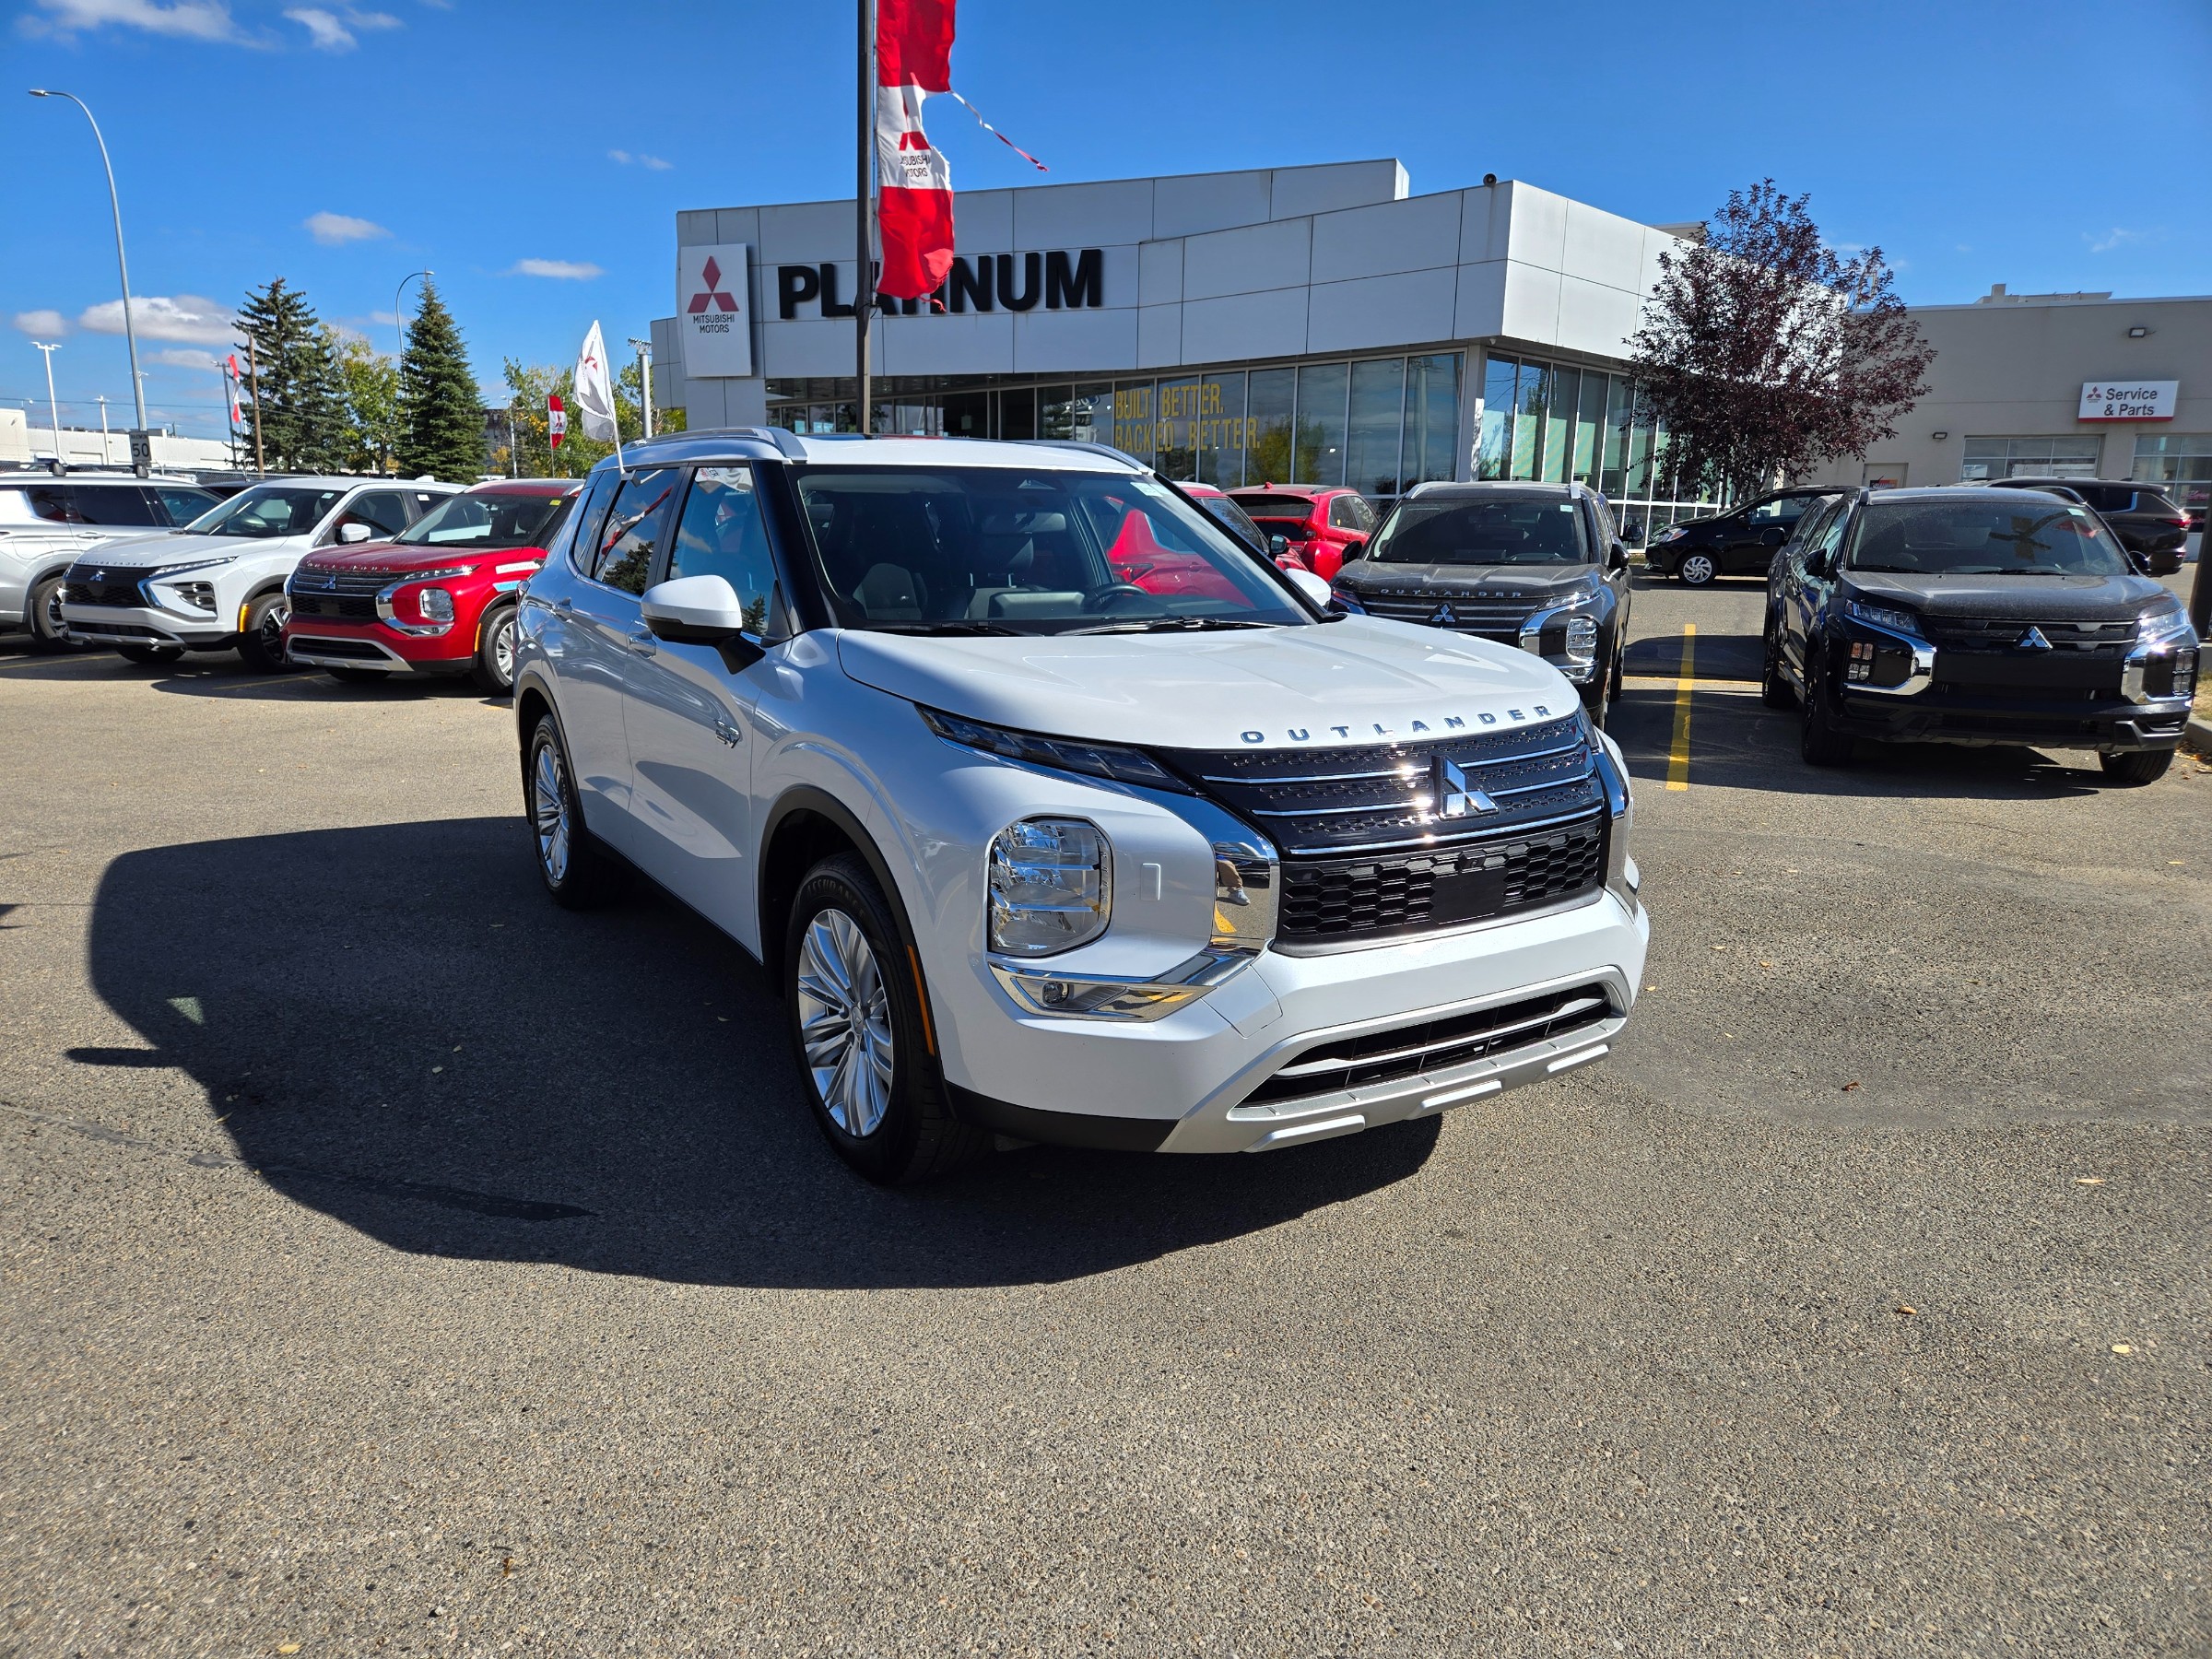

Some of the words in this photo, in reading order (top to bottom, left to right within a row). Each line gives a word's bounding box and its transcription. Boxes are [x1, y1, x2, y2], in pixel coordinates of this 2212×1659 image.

[778, 249, 1102, 319] PLNUM
[693, 314, 735, 324] MITSUBISHI
[700, 324, 730, 333] MOTORS
[2105, 387, 2158, 400] Service
[1116, 389, 1151, 419] BUILT
[1162, 383, 1224, 418] BETTER.
[2104, 404, 2113, 416] &
[2119, 404, 2155, 416] Parts
[1115, 420, 1174, 453] BACKED
[1188, 417, 1261, 451] BETTER.
[132, 443, 148, 457] 50
[1240, 705, 1551, 744] OUTLANDER
